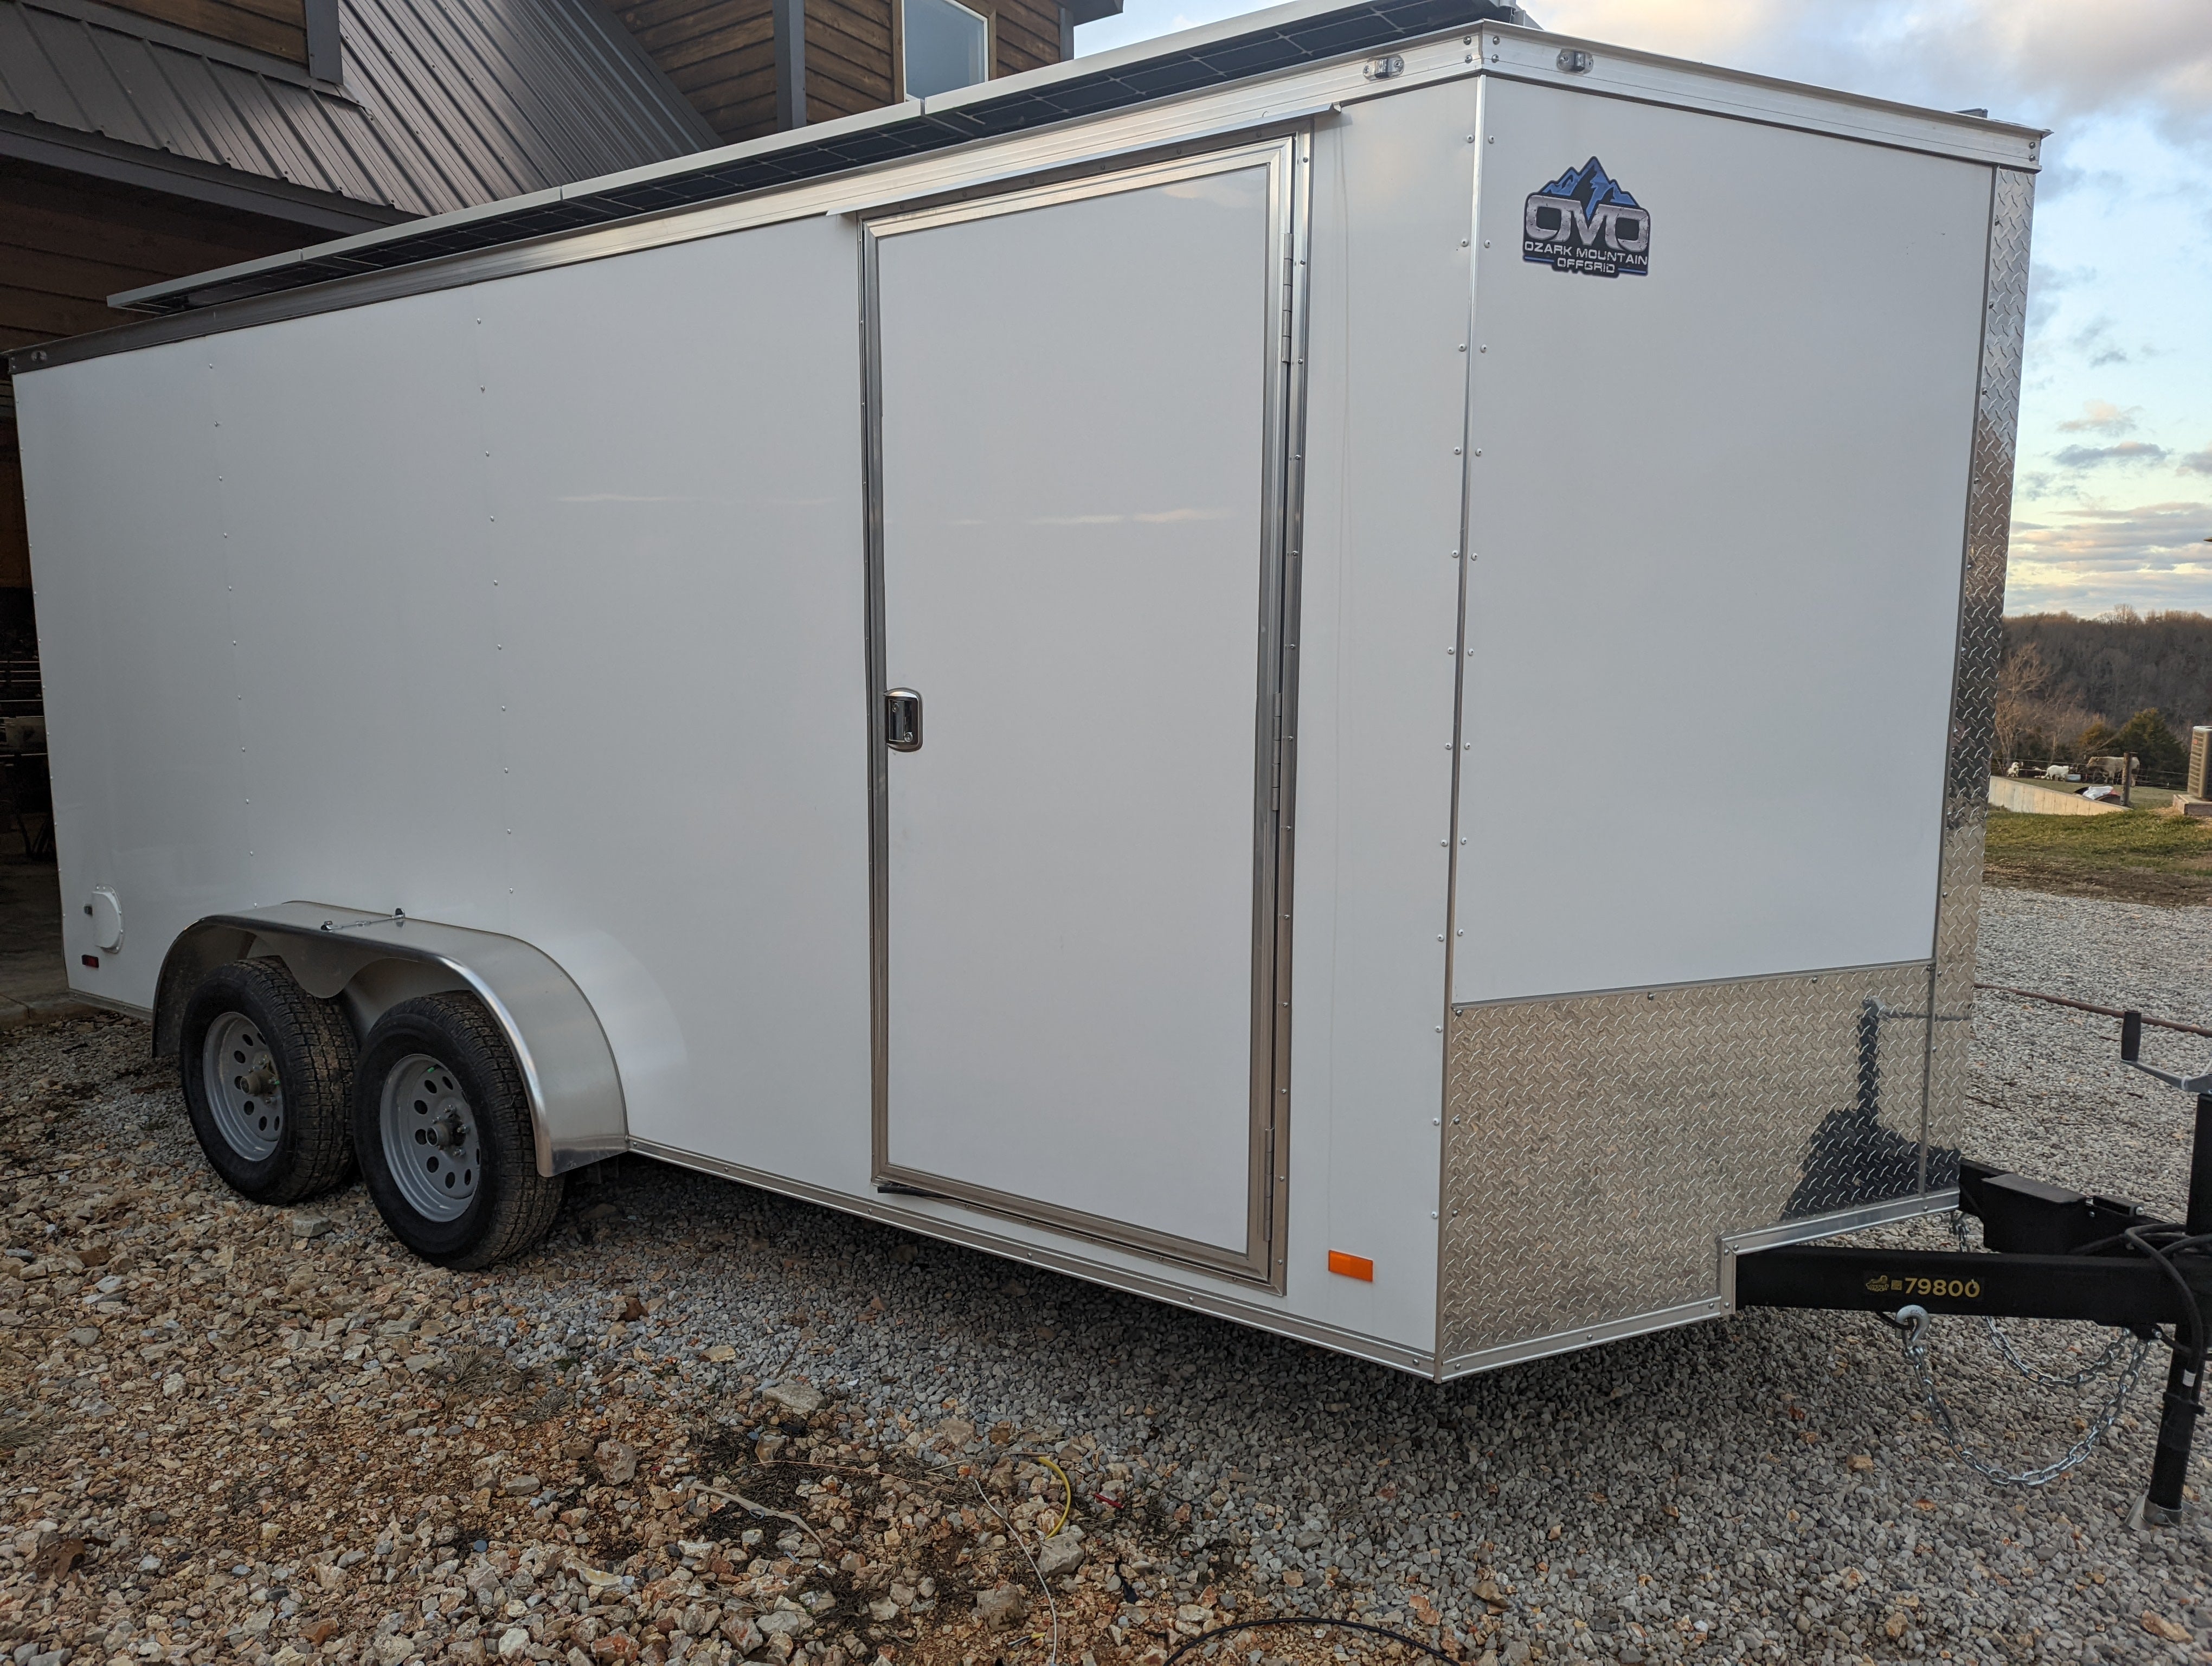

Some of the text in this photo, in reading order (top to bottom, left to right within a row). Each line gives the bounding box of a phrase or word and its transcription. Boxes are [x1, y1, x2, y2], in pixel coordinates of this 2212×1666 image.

[1524, 241, 1648, 265] OZARK MOUNTAIN
[1557, 258, 1615, 273] OFFGRID
[1905, 1278, 1980, 1298] 79800
